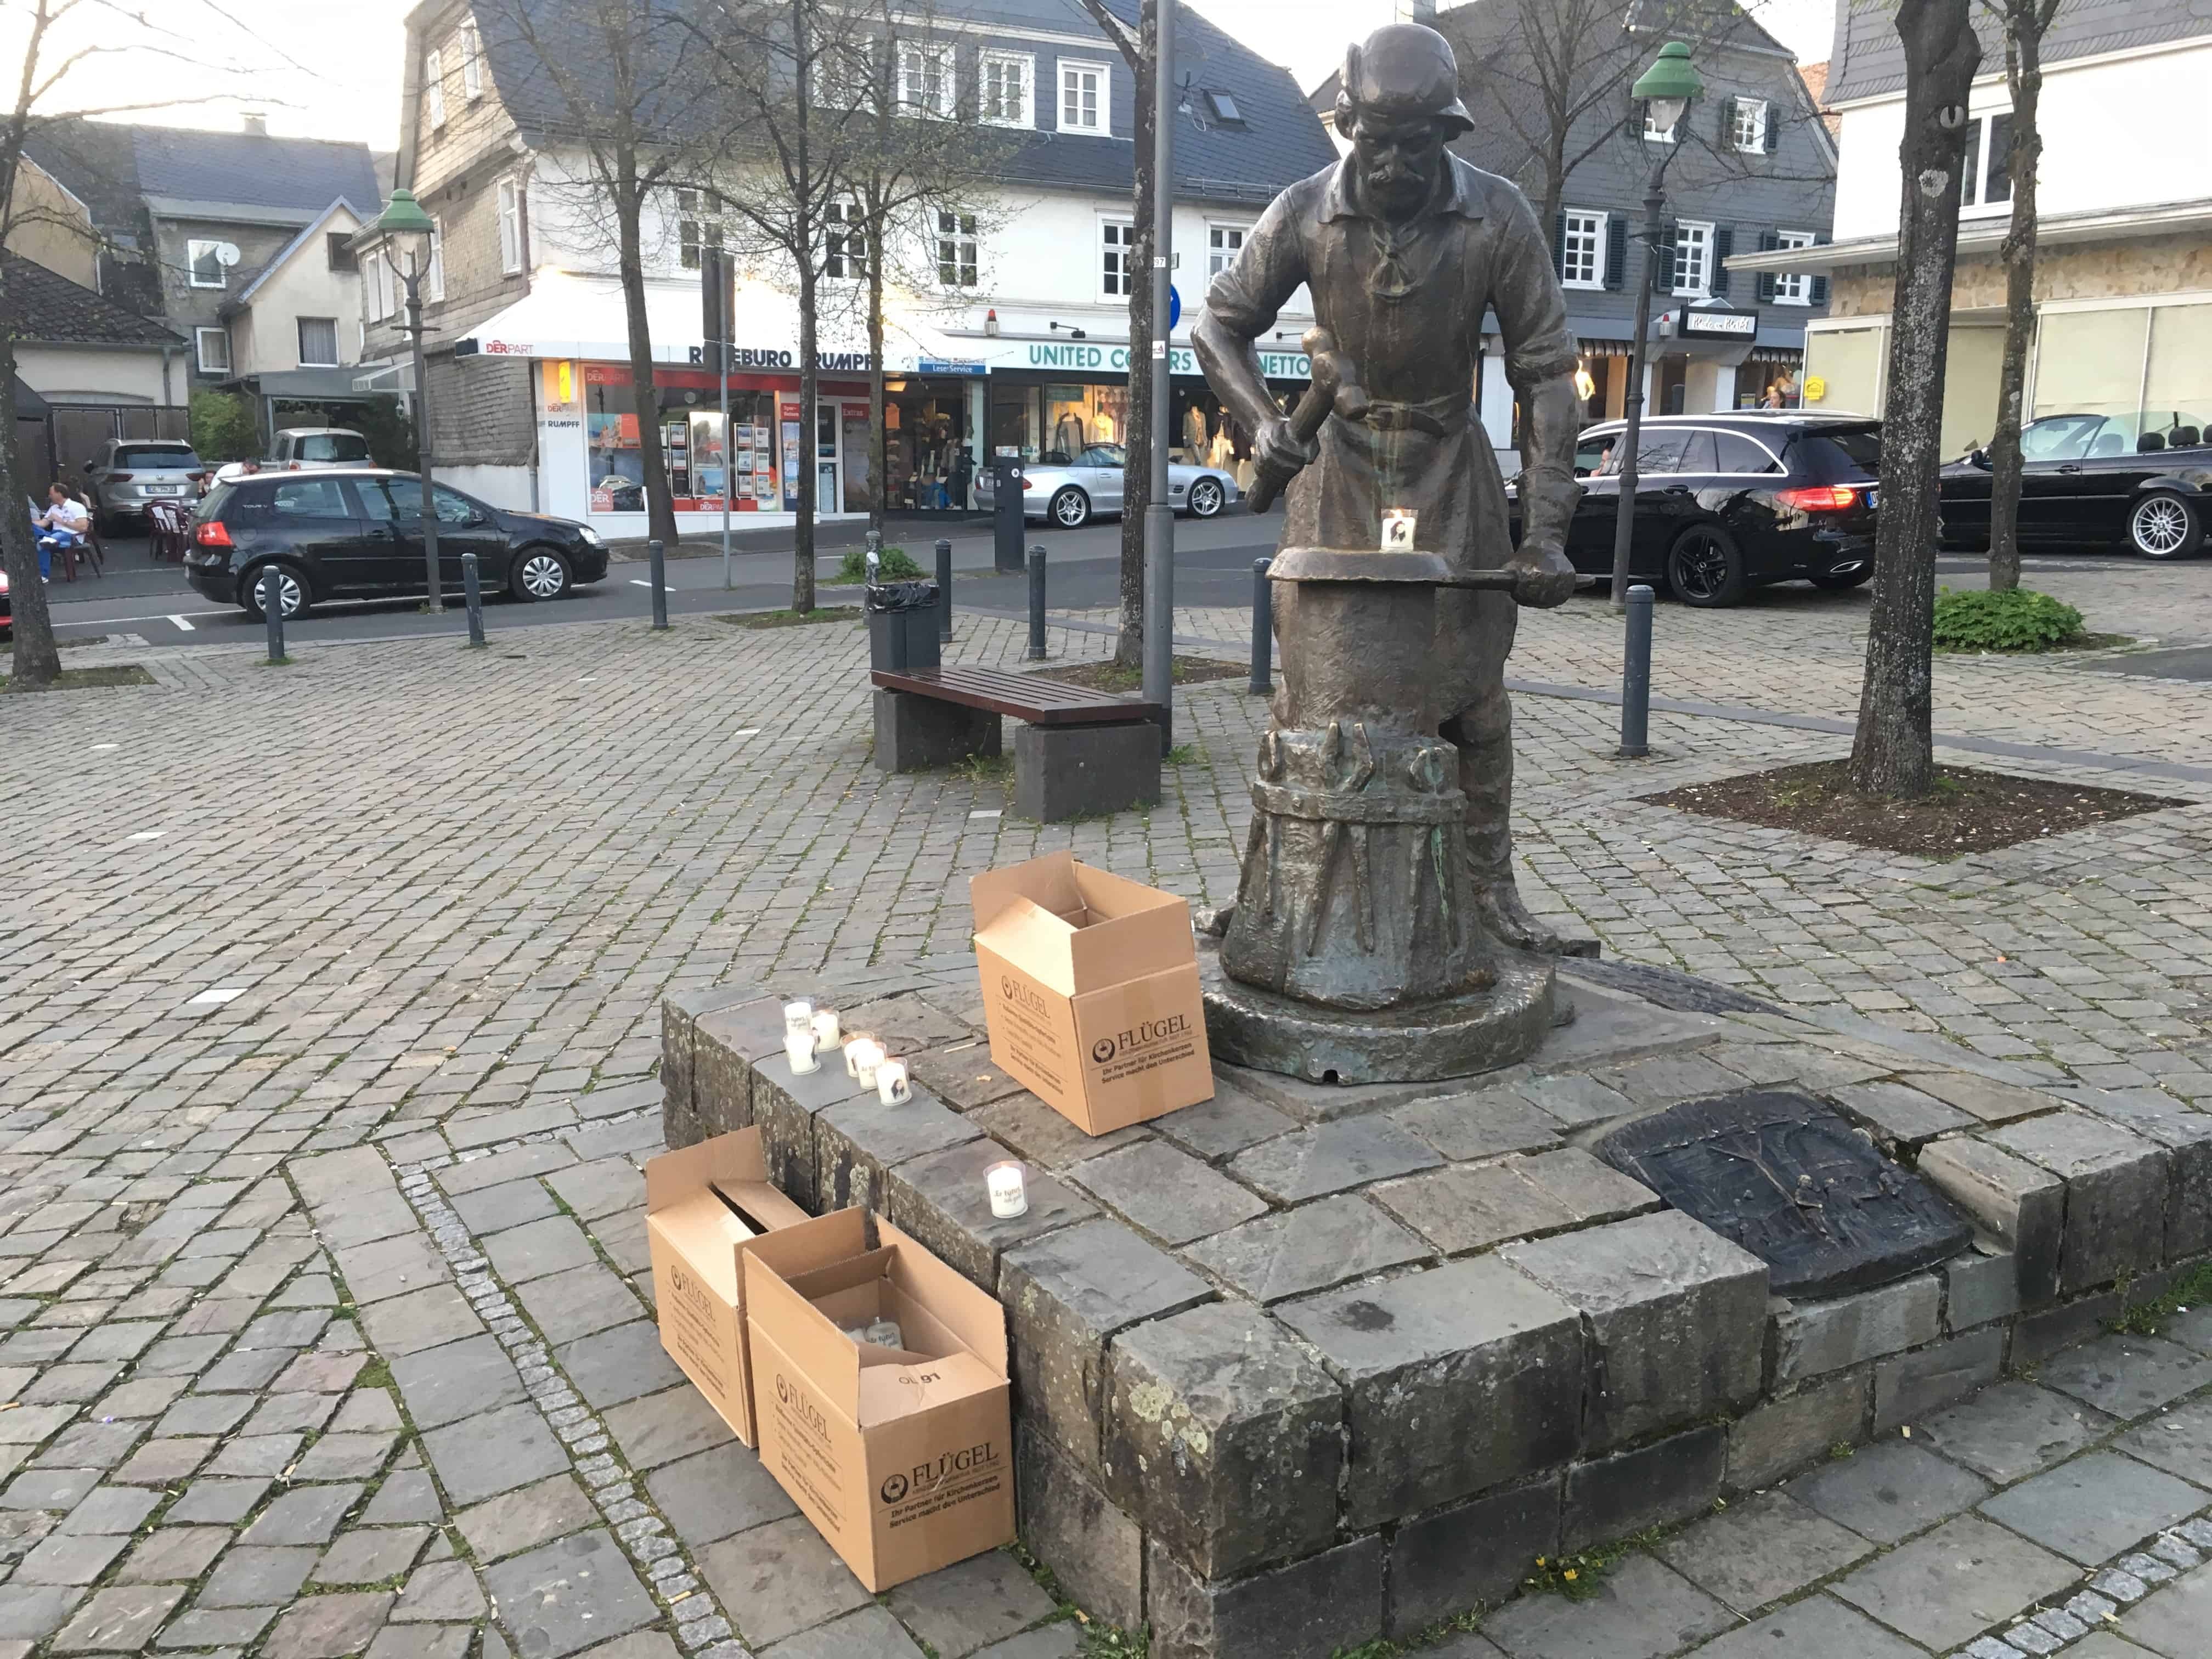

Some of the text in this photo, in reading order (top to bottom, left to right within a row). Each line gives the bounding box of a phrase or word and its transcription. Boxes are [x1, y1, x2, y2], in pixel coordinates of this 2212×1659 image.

[486, 342, 534, 354] DERPART
[1029, 345, 1311, 376] UNITED CRS NETTO
[1012, 979, 1050, 1019] FLÜGEL
[1118, 1013, 1191, 1050] FLÜGEL
[1114, 1059, 1137, 1071] Partner
[1102, 1073, 1124, 1084] Service
[920, 1372, 941, 1384] 91
[912, 1442, 1000, 1487] FLÜGEL
[891, 1509, 903, 1518] Ihr
[905, 1497, 933, 1512] Partner
[889, 1513, 917, 1528] Service
